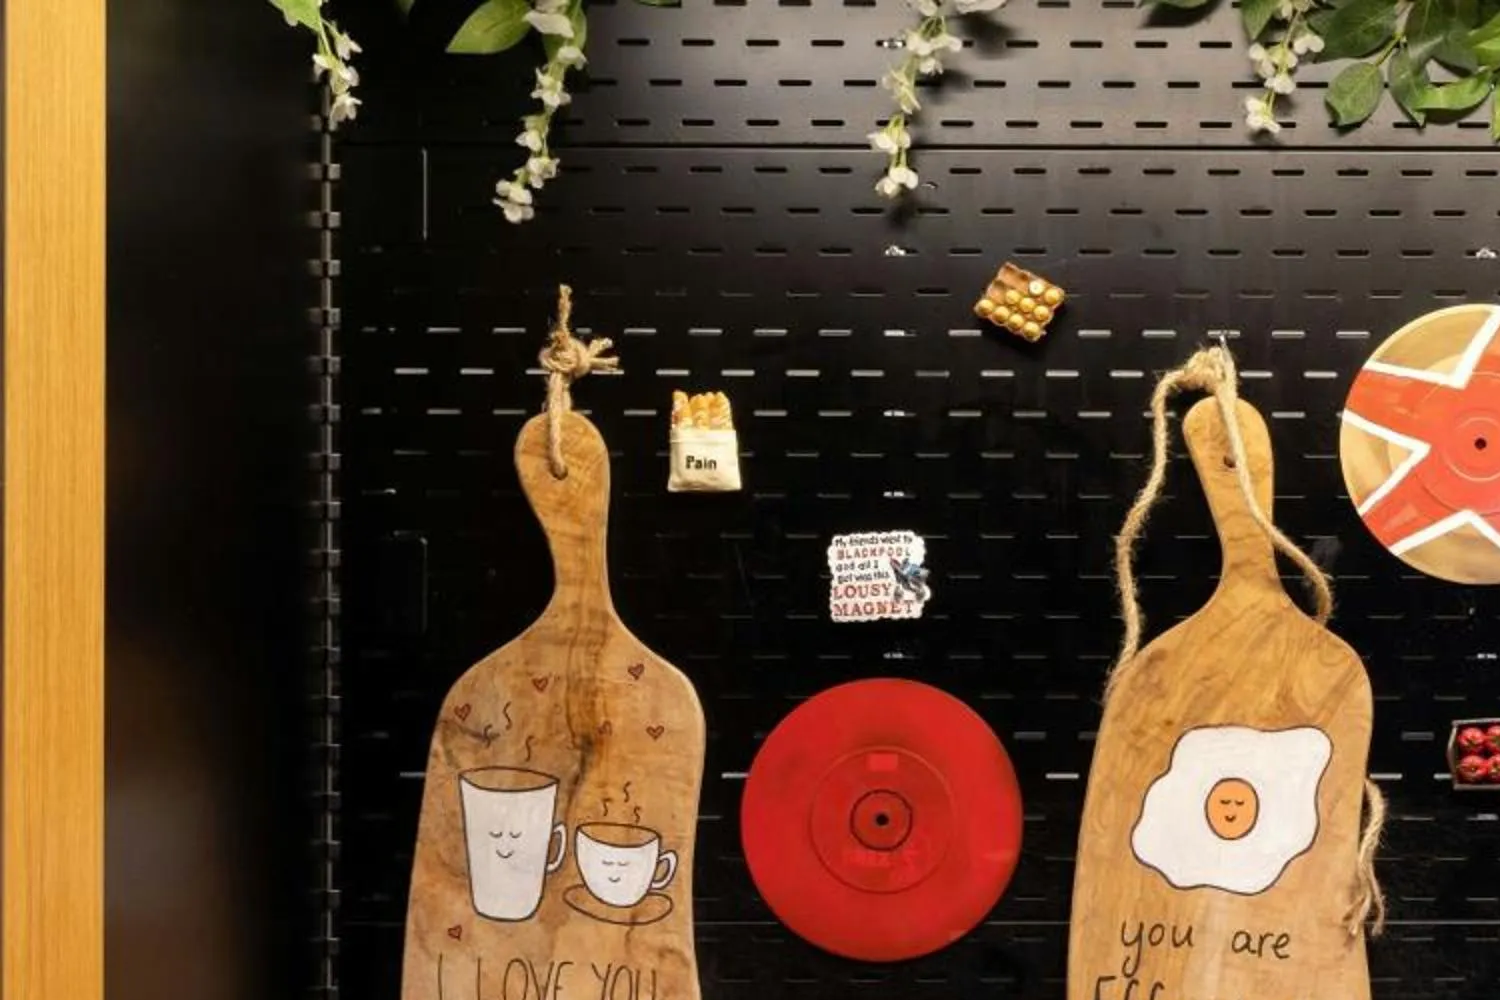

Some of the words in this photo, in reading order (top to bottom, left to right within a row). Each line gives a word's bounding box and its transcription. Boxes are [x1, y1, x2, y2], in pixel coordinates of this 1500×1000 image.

[686, 455, 717, 470] Pain
[836, 546, 911, 560] BLACKPOOL
[833, 583, 891, 600] LOUSY
[833, 600, 913, 617] MAGNET
[1120, 918, 1194, 978] you
[1230, 929, 1291, 960] are
